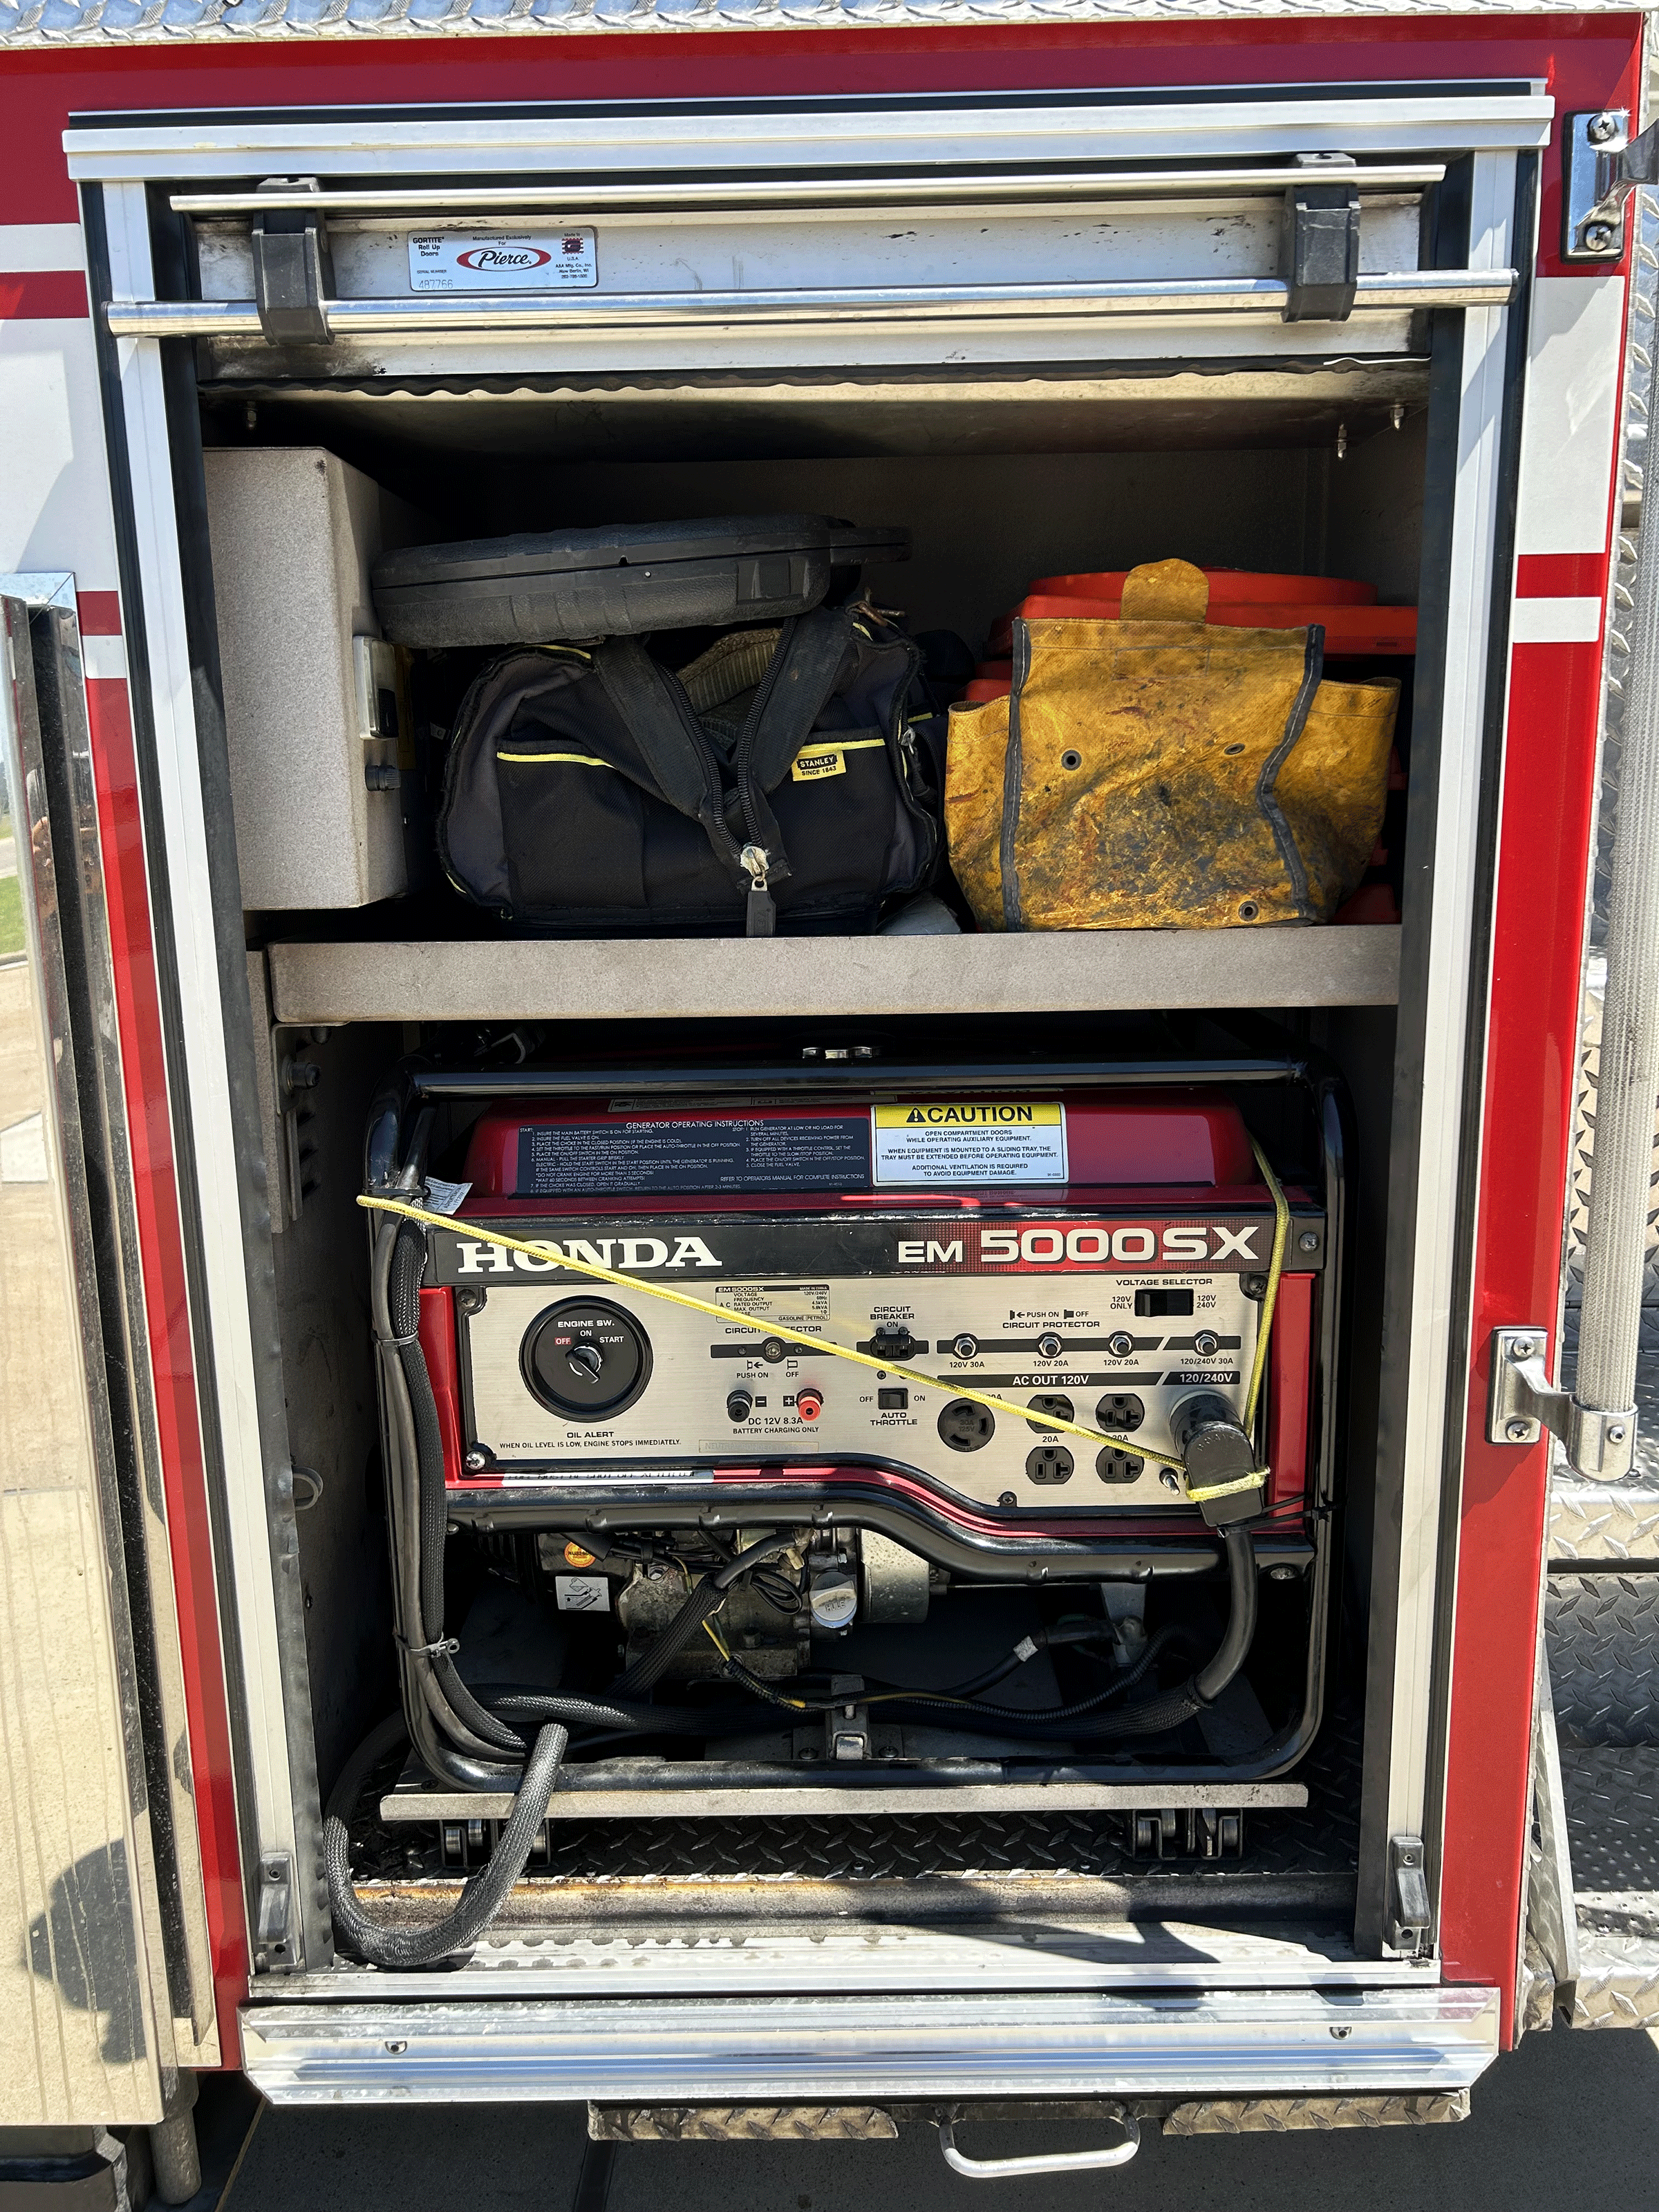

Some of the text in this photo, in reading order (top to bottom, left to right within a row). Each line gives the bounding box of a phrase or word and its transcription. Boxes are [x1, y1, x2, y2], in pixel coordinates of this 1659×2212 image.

[419, 279, 453, 289] 487766
[800, 756, 834, 767] STANLEY
[928, 1107, 1033, 1123] CAUTION
[672, 1121, 713, 1129] OPERATING
[898, 1227, 1259, 1264] EM 5000SX
[456, 1236, 722, 1273] HONDA
[1013, 1375, 1089, 1385] AC OUT 120V
[1180, 1374, 1233, 1382] 120/240V
